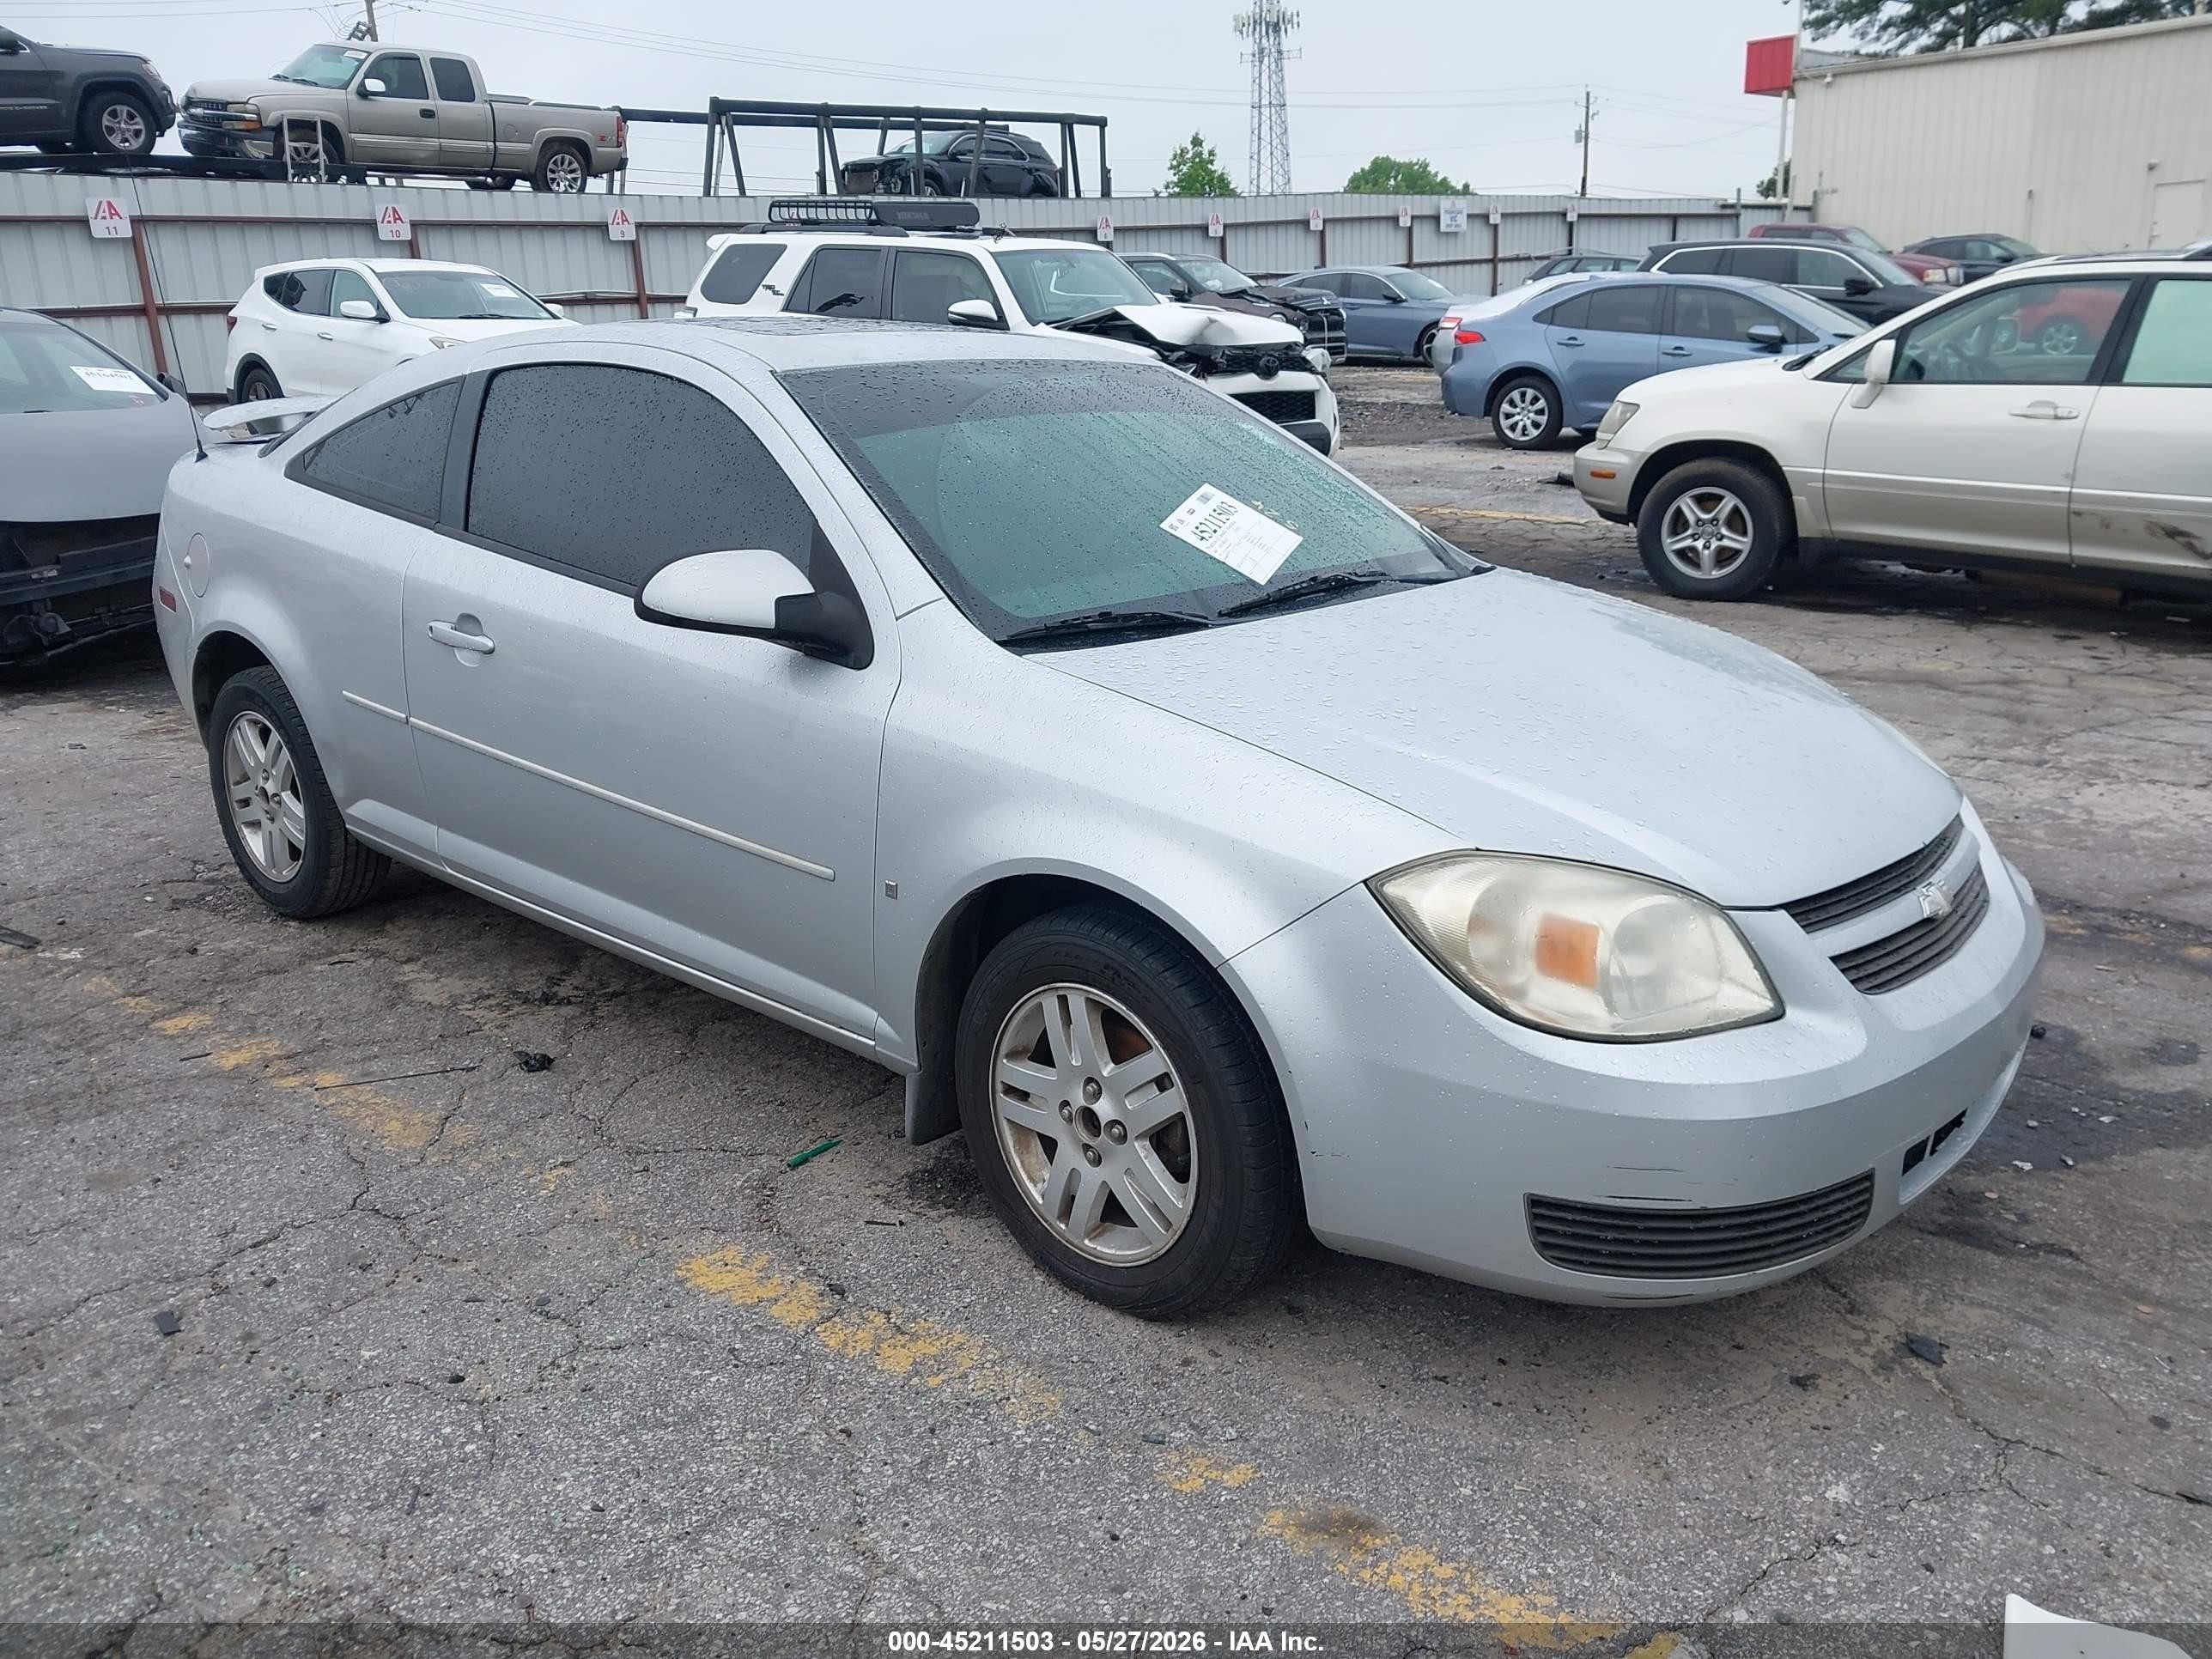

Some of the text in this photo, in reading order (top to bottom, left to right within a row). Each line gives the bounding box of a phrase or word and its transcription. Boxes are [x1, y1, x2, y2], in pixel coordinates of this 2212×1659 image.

[105, 226, 118, 236] 11
[389, 229, 401, 239] 10
[619, 229, 626, 239] 9
[1190, 501, 1239, 542] 45211503
